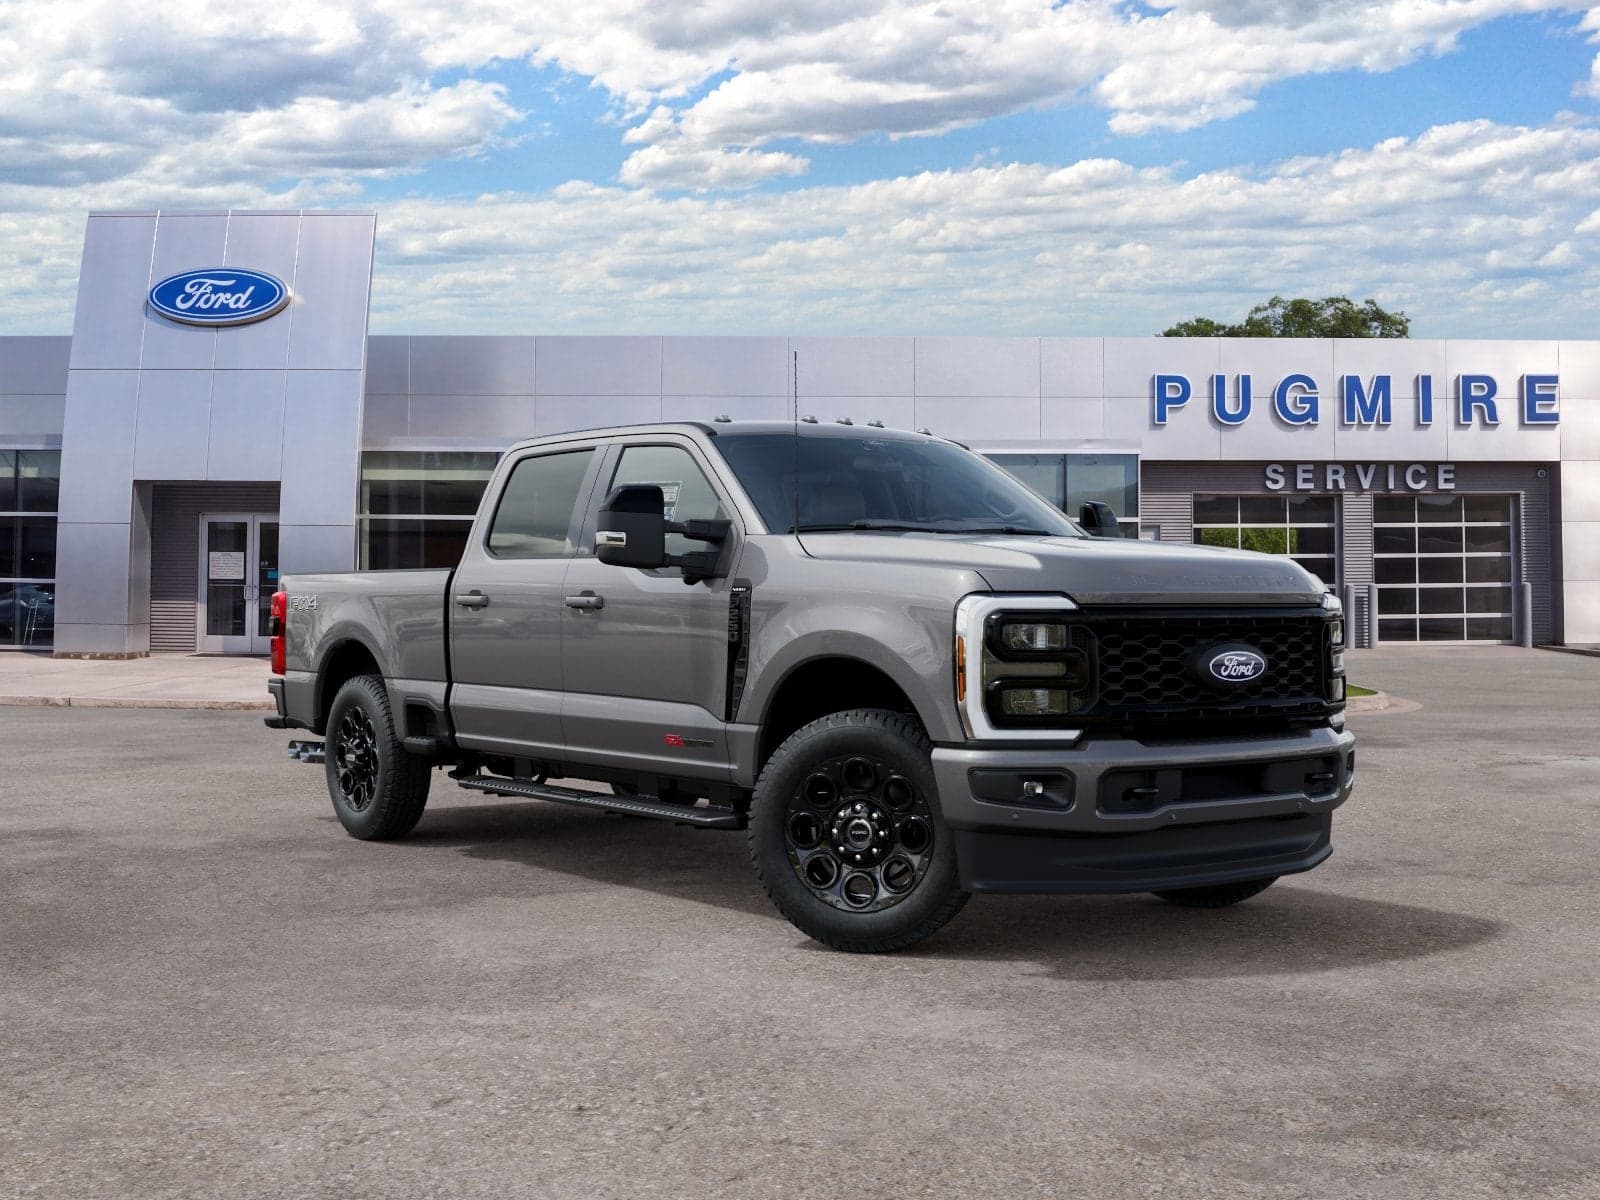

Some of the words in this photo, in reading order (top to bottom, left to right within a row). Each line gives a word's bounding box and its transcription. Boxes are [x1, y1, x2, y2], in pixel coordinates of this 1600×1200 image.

[175, 278, 255, 309] Ford
[1154, 373, 1560, 426] PUGMIRE
[1265, 463, 1456, 491] SERVICE
[289, 595, 319, 613] FX4
[1220, 655, 1255, 676] Ford
